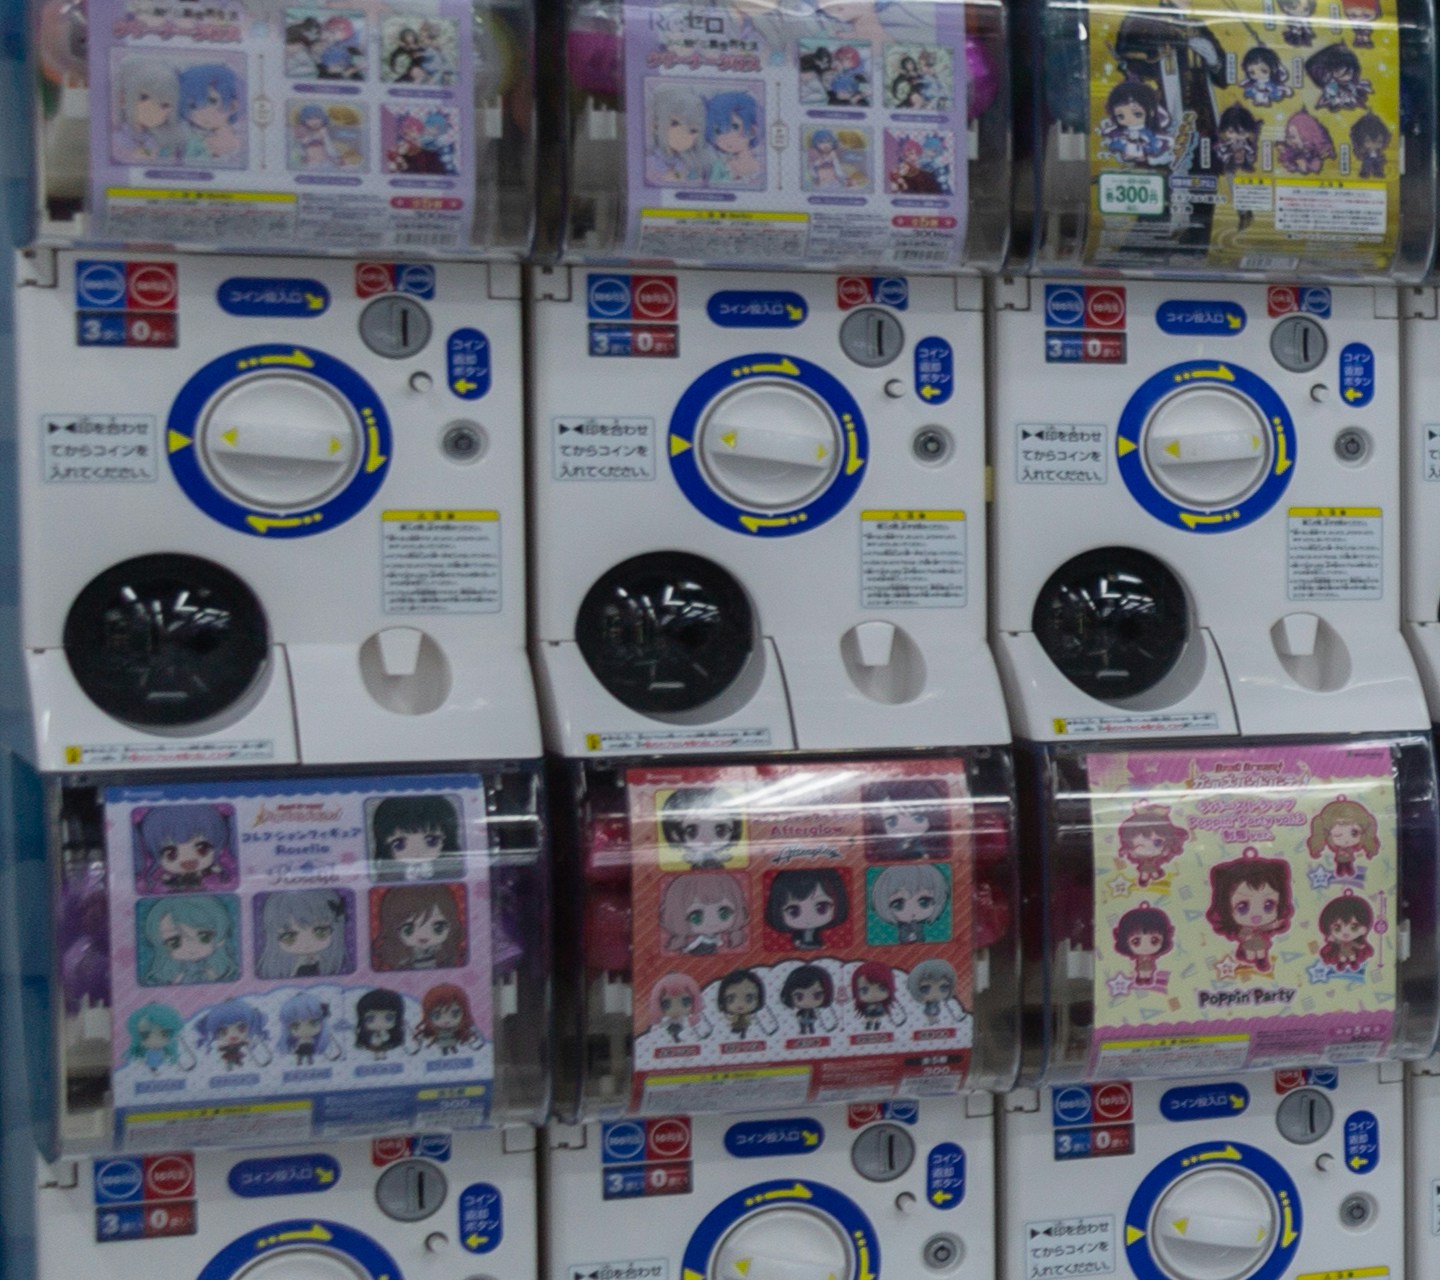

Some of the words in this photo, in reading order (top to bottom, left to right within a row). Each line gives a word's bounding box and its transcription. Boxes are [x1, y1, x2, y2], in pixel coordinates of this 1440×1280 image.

[1343, 352, 1371, 363] コイン
[559, 444, 648, 458] てからコインを
[1022, 449, 1102, 463] てからコインを
[1348, 1120, 1374, 1131] コイン
[1031, 1242, 1109, 1258] てからコインを
